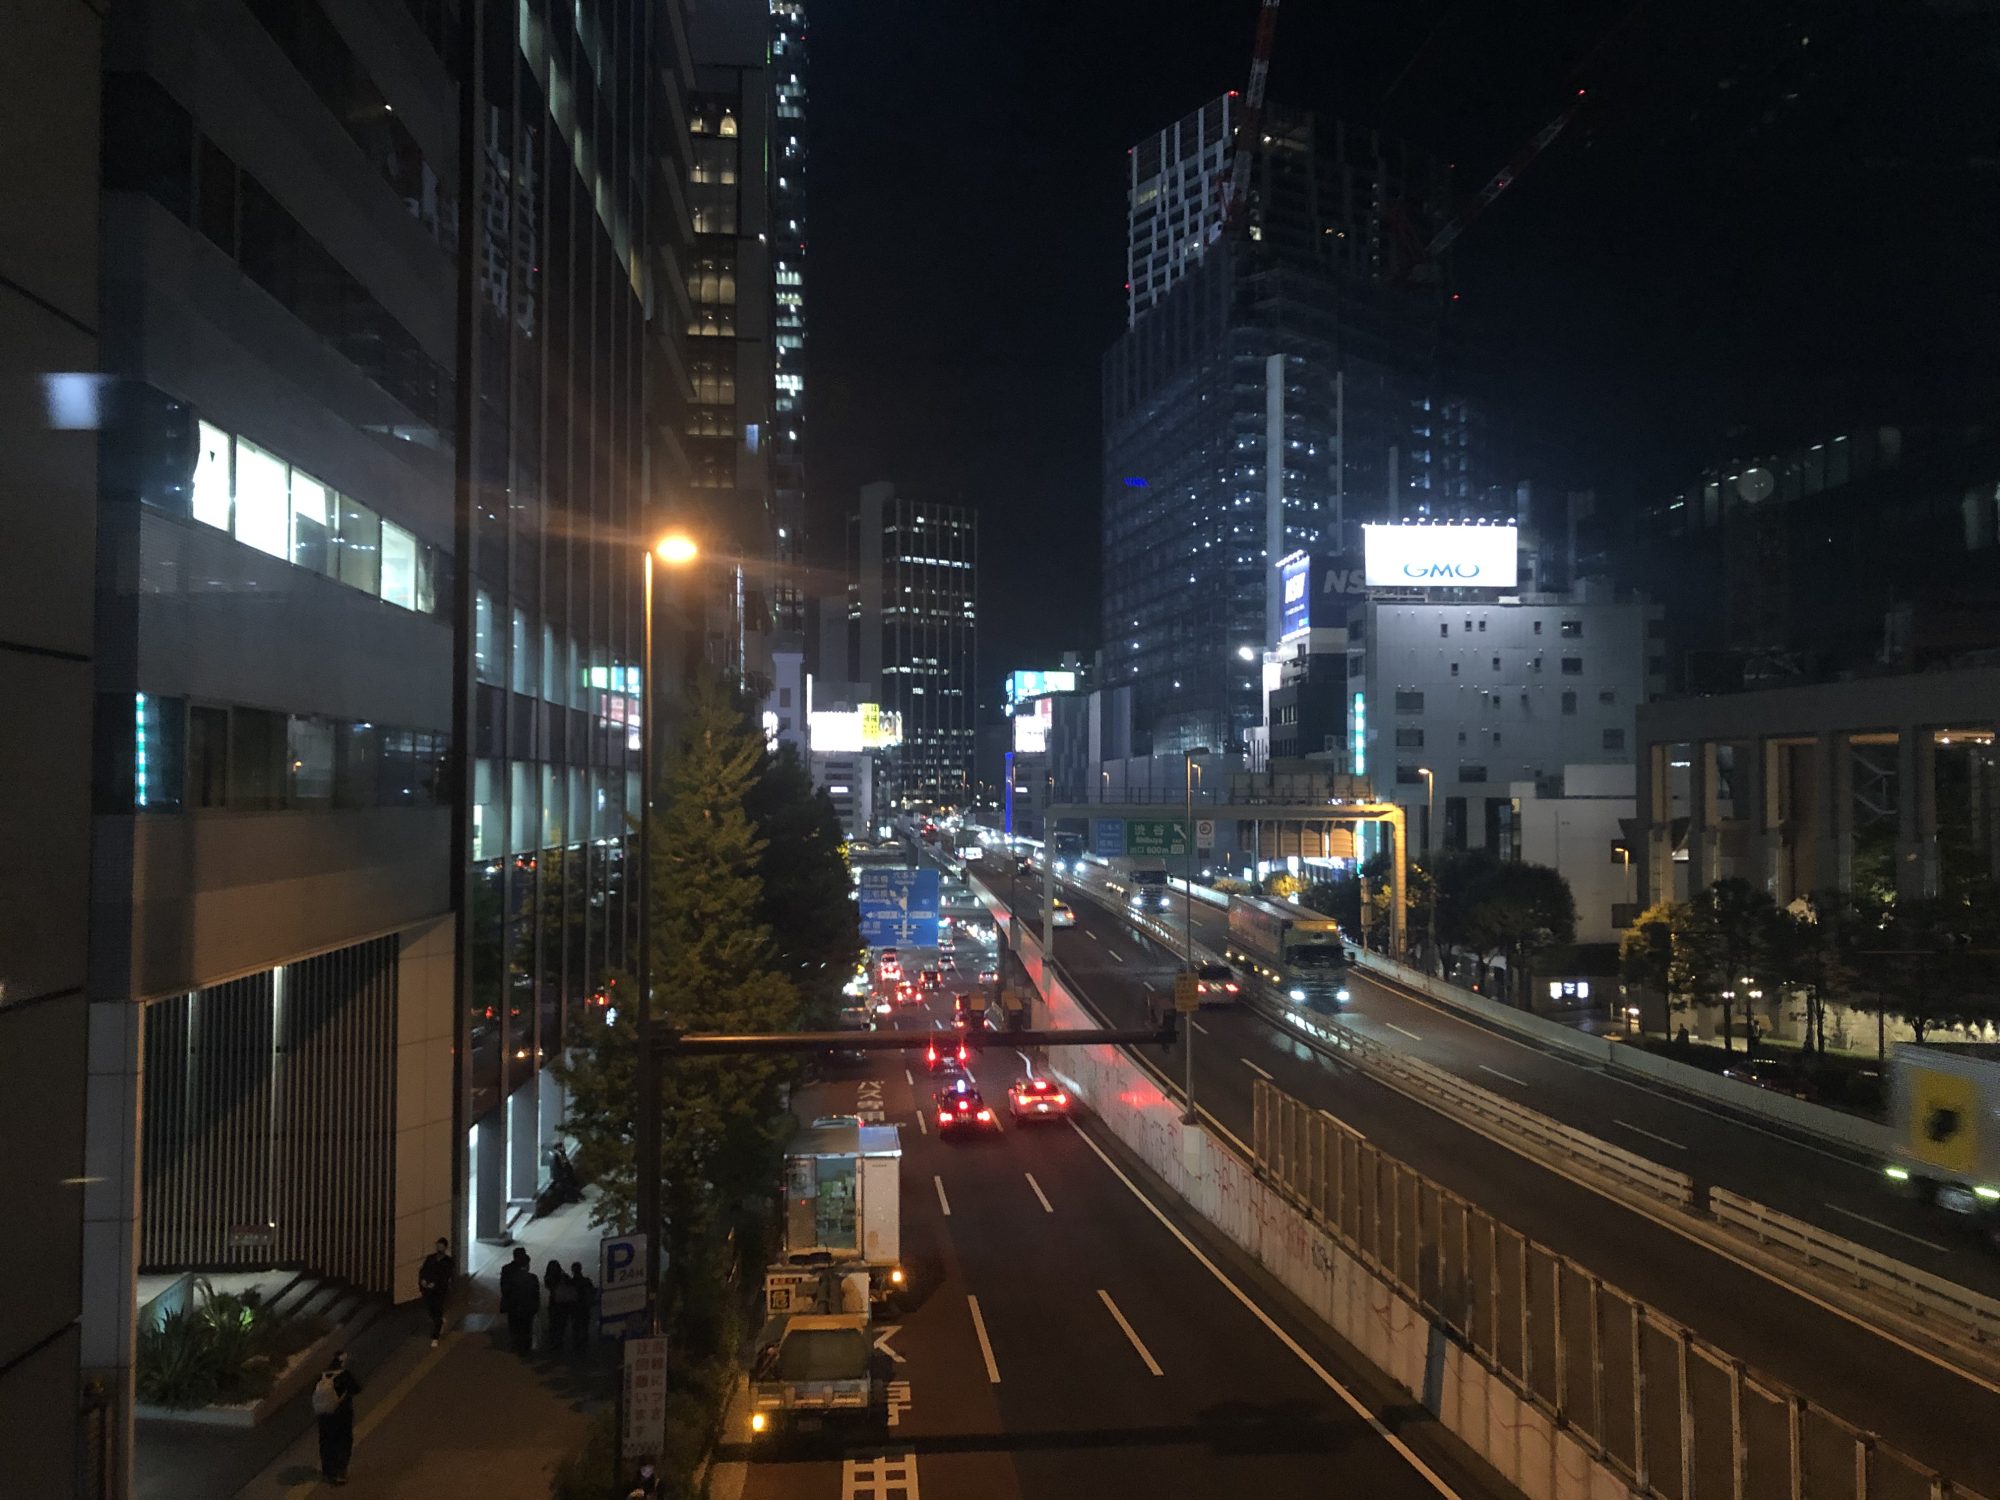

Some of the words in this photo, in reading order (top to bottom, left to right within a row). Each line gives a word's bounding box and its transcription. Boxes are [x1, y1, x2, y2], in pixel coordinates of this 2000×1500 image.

[1403, 562, 1480, 578] GMO
[1134, 824, 1165, 836] 渋谷
[1135, 836, 1163, 845] Shibuya
[607, 1242, 634, 1283] P
